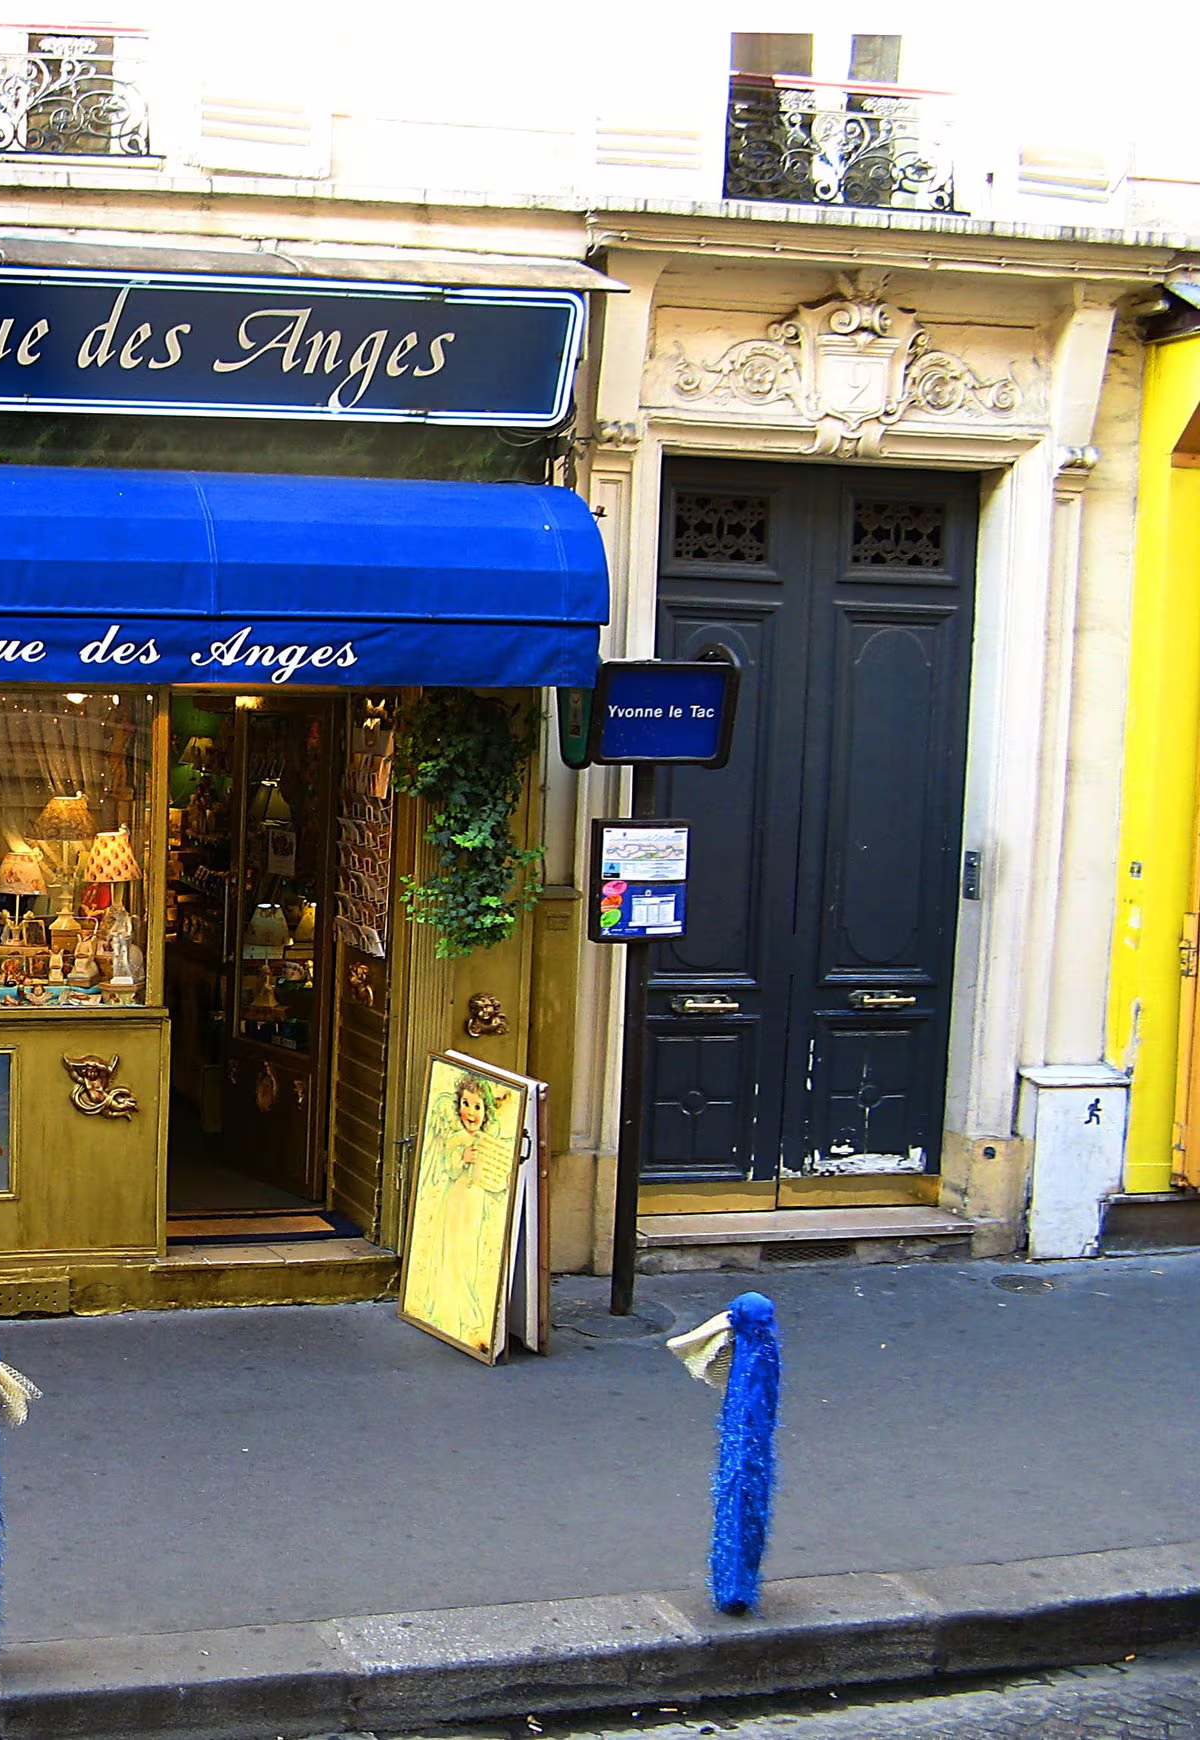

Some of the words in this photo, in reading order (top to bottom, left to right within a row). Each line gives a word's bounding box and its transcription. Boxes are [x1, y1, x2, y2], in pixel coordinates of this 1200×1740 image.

[78, 280, 192, 370] des
[214, 307, 455, 414] Anges
[79, 625, 161, 666] des
[191, 627, 358, 683] Anges
[608, 705, 663, 718] Yvonne
[668, 705, 683, 718] le
[690, 705, 715, 718] Tac
